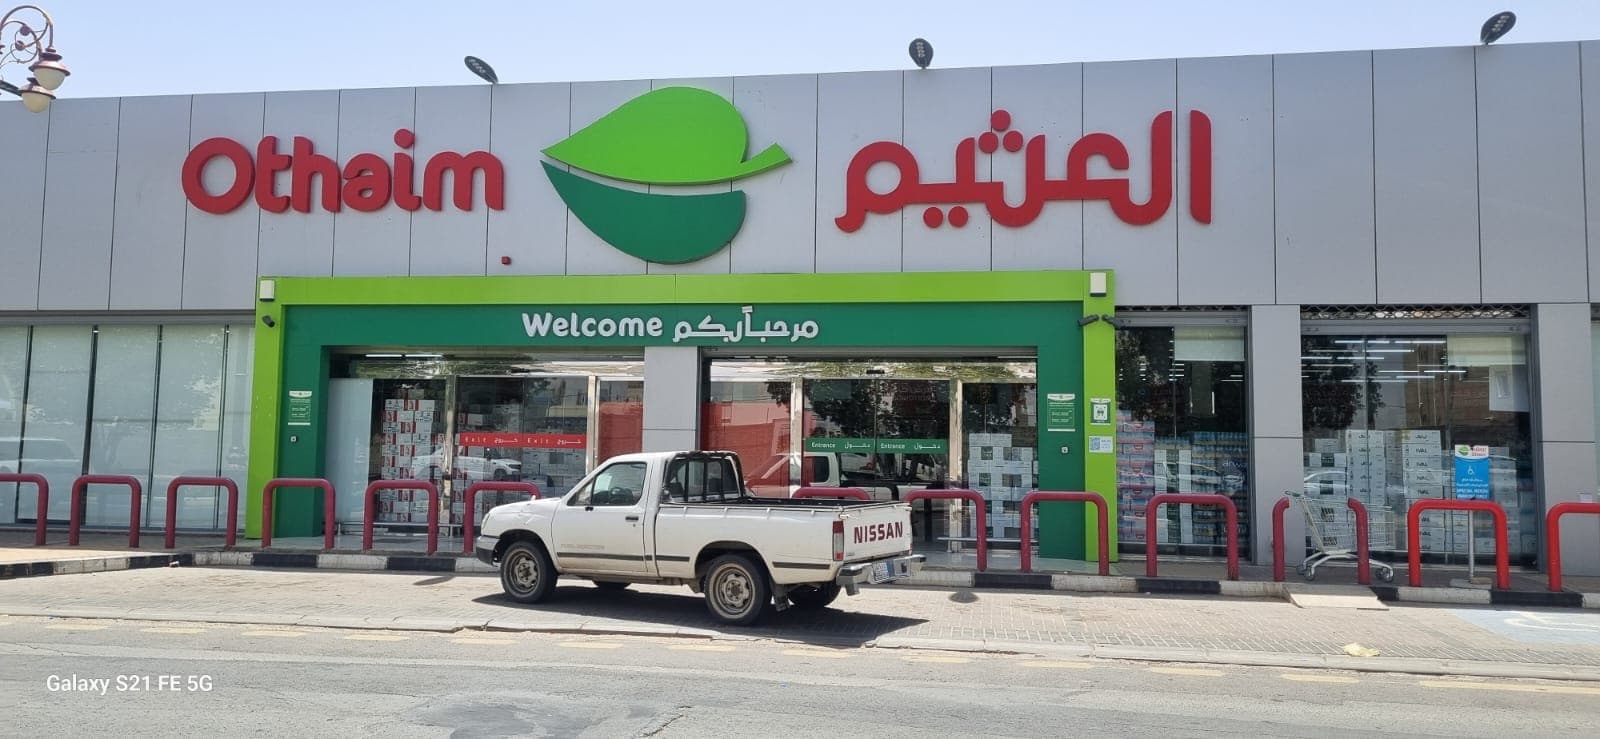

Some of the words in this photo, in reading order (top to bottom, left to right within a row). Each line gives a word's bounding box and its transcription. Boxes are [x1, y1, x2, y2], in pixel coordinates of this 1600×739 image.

[181, 128, 505, 214] Othaim
[834, 109, 1212, 233] العثيم
[522, 312, 663, 338] Welcome
[811, 441, 836, 449] Entrance
[880, 442, 906, 450] Entrance
[854, 521, 904, 544] NISSAN
